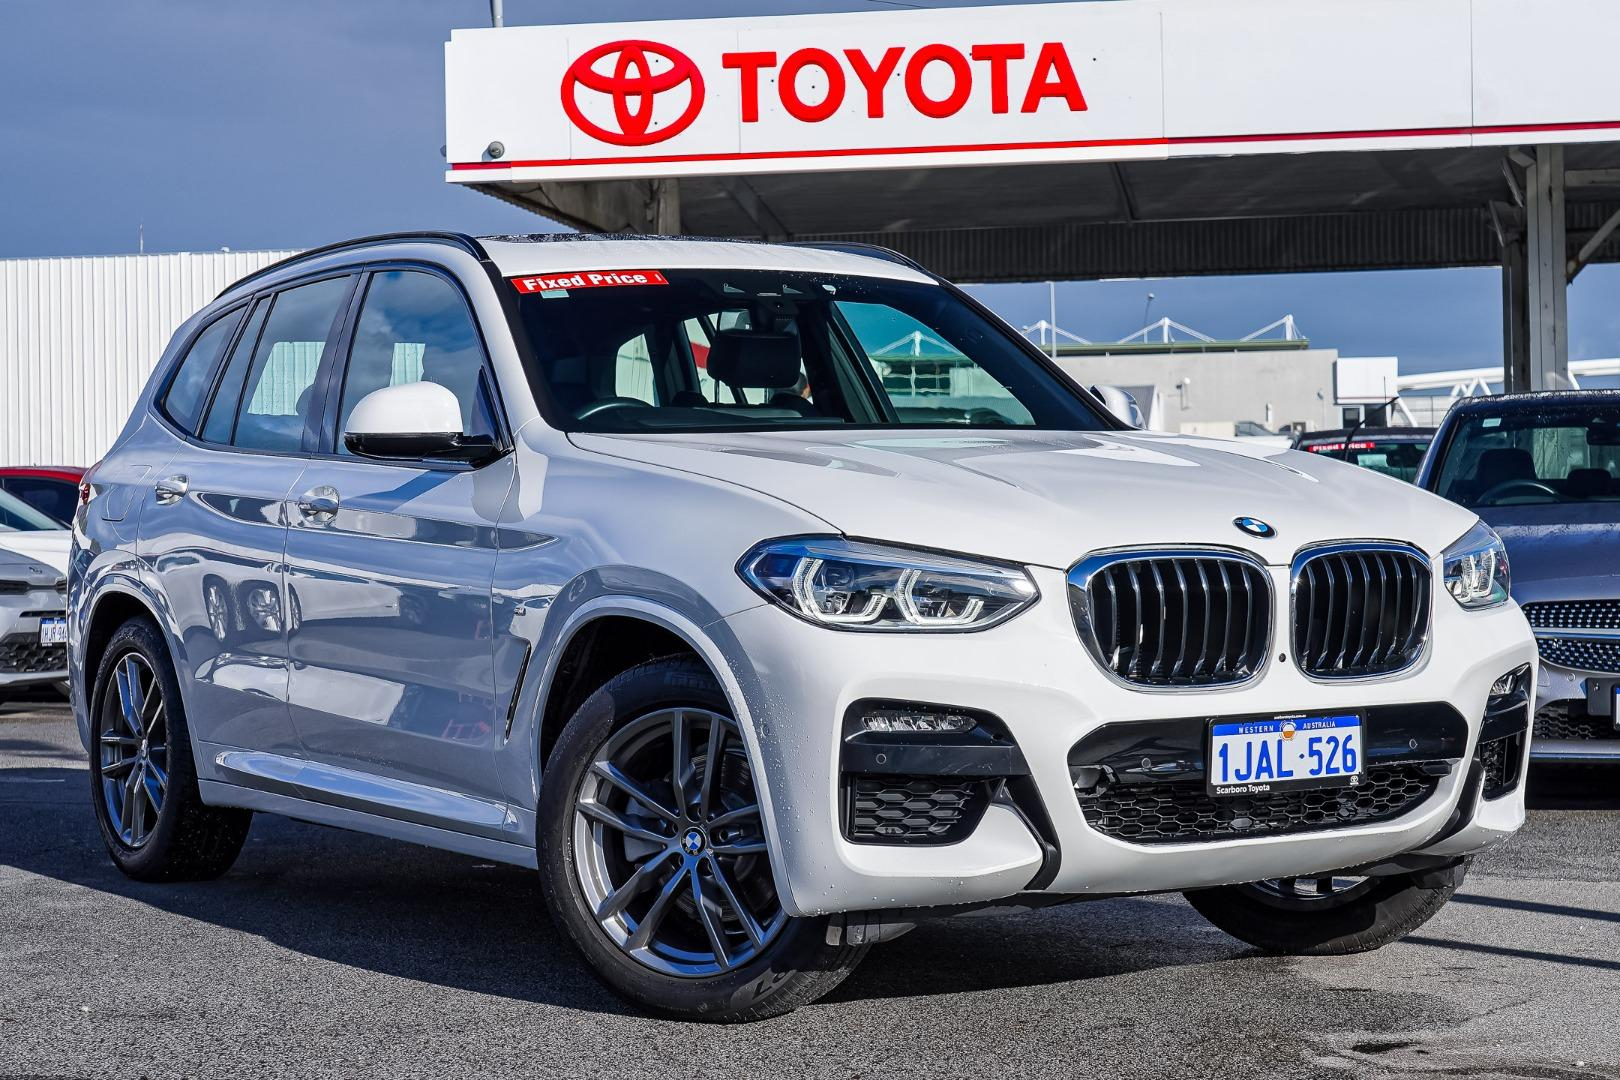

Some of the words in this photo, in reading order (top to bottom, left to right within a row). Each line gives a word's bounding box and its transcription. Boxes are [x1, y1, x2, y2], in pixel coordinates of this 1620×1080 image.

[722, 42, 1088, 124] TOYOTA
[522, 274, 586, 291] Fixed
[587, 273, 648, 285] Price
[1238, 725, 1274, 734] WESTERN
[1302, 720, 1336, 730] AUSTRALIA
[1216, 785, 1247, 795] Scarboro
[1248, 783, 1270, 794] Toyota
